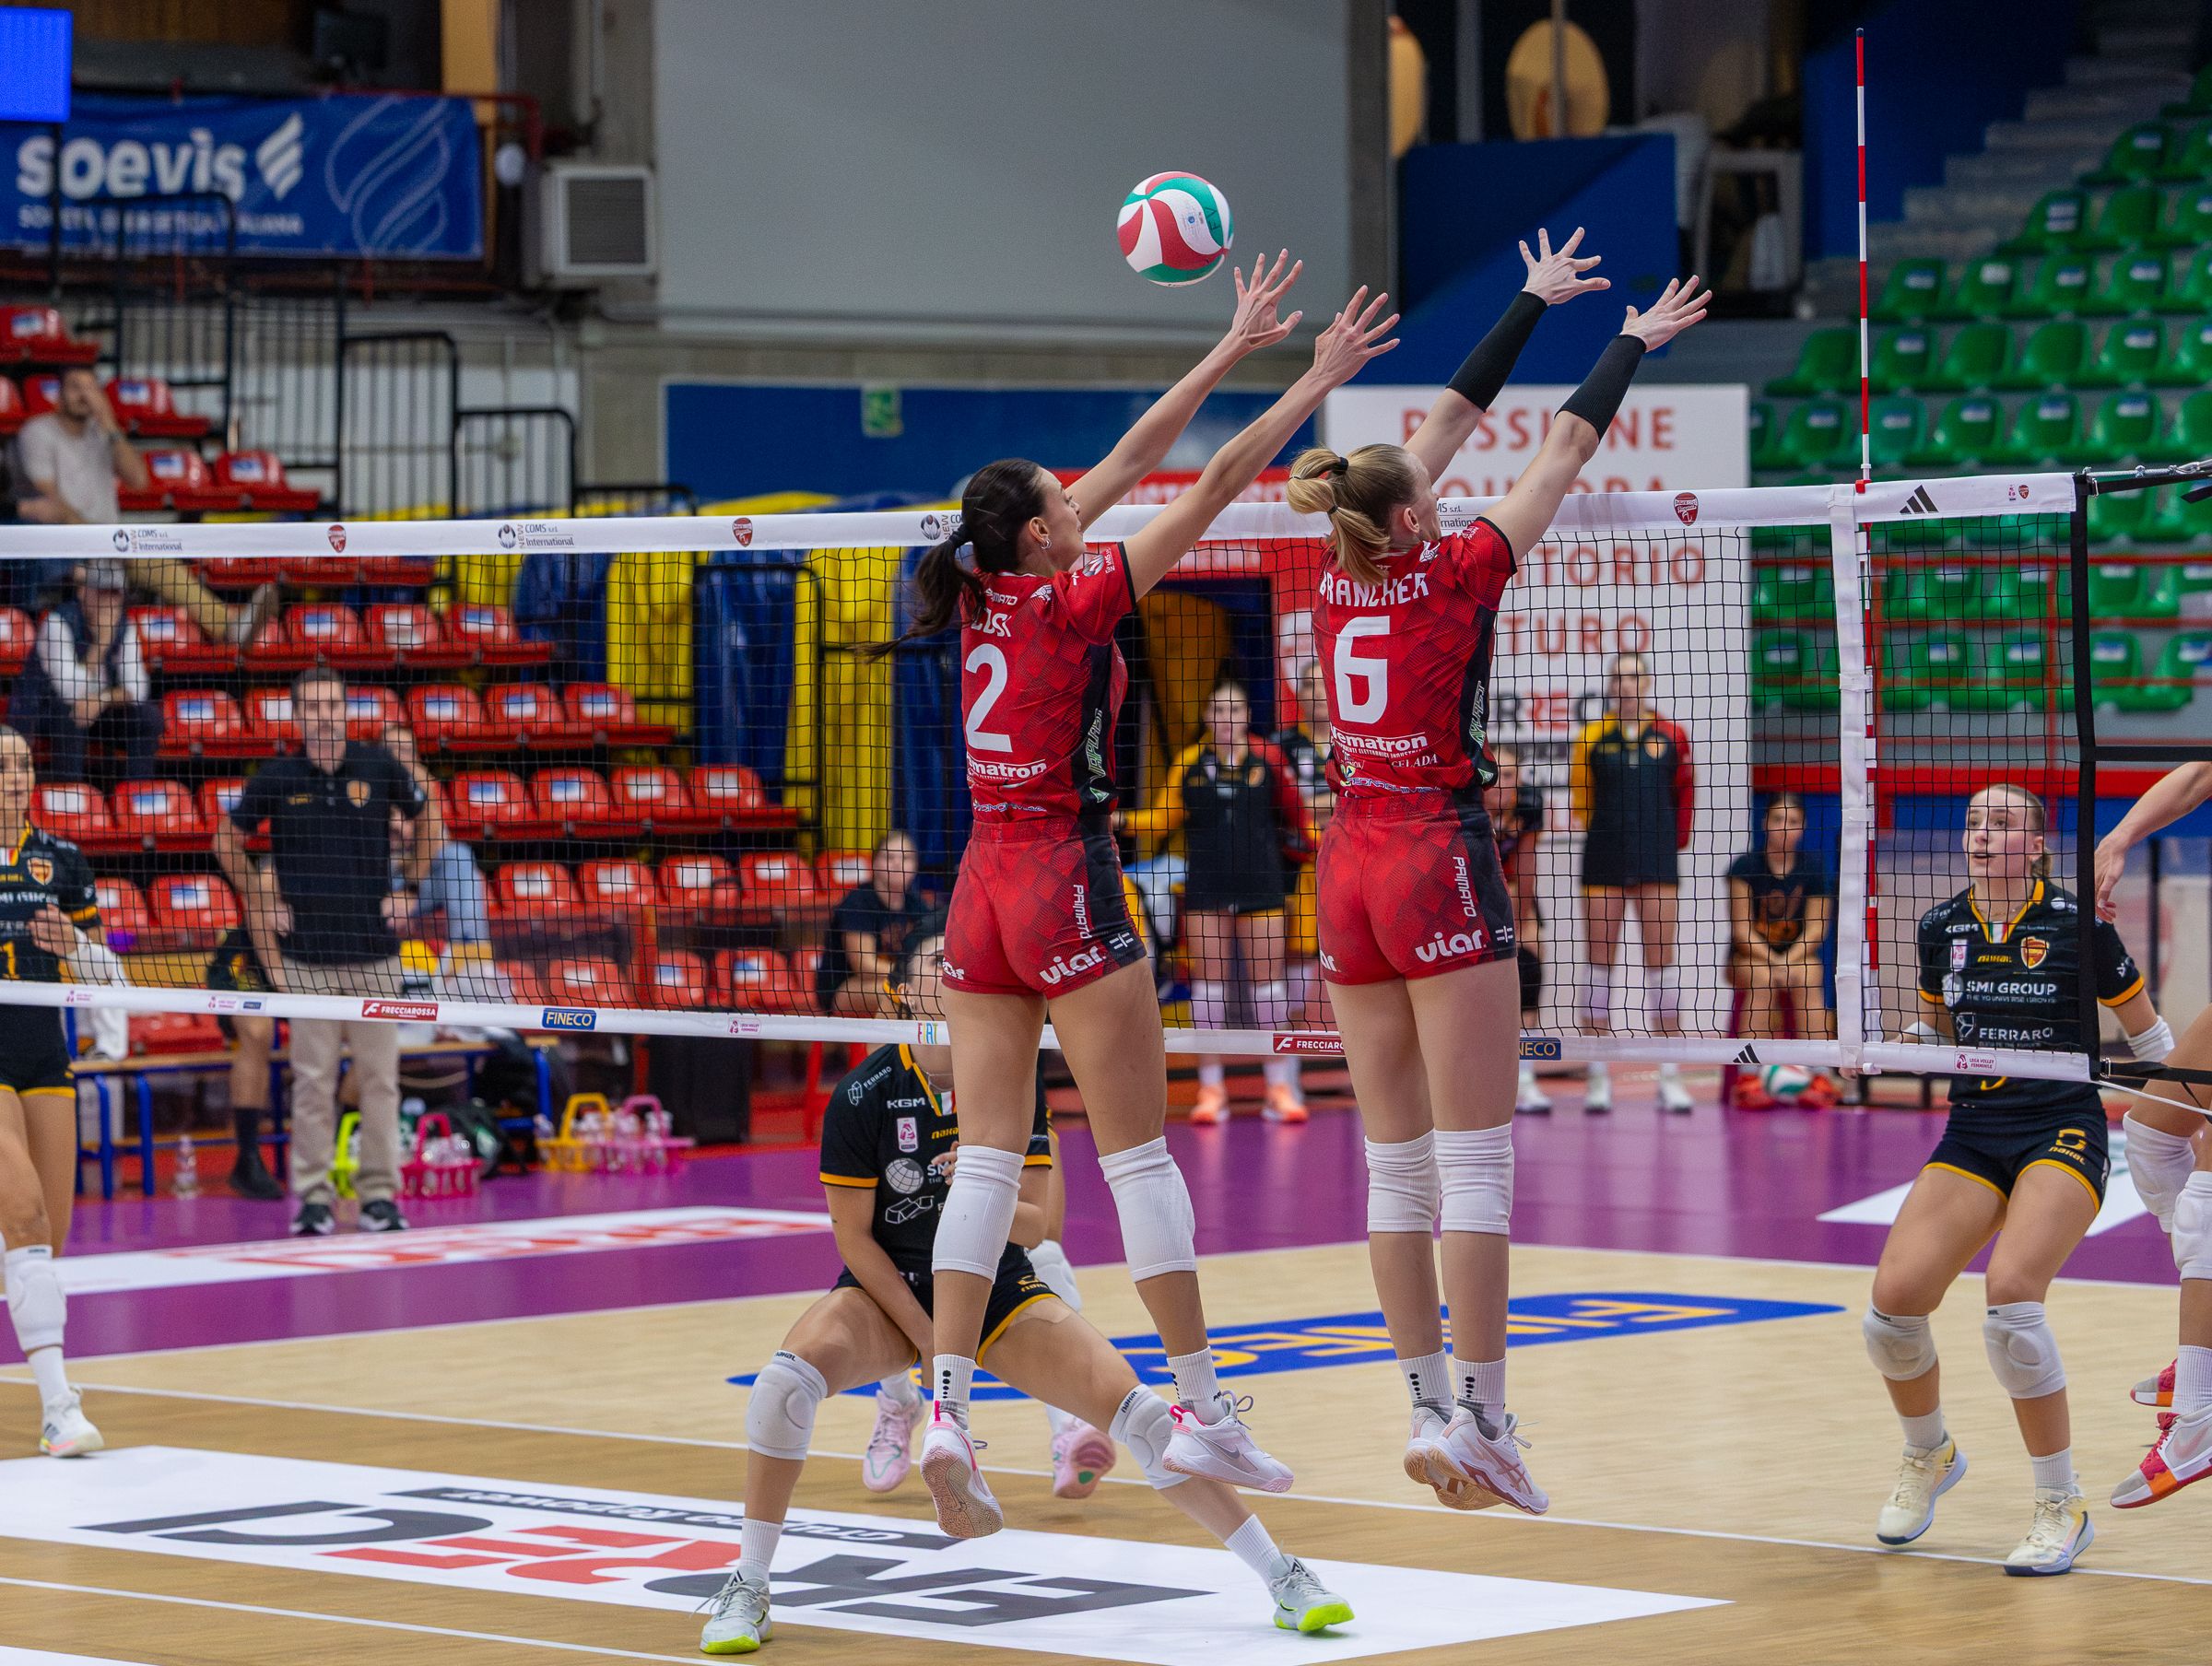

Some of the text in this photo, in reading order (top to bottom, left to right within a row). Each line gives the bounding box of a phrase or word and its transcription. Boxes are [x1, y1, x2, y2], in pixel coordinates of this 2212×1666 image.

[524, 523, 547, 534] COMS
[138, 542, 182, 552] International
[525, 536, 574, 546] International
[1500, 614, 1650, 657] TURO
[1333, 615, 1392, 725] 6
[965, 643, 1013, 754] 2
[1966, 980, 2057, 996] SMI GROUP
[381, 1005, 436, 1016] FRECCIAROSSA
[546, 1012, 593, 1027] FINECO
[917, 1021, 939, 1045] FIAT
[1979, 1027, 2053, 1041] FERRARO
[864, 1066, 892, 1088] FERRARO
[887, 1097, 925, 1109] KGM
